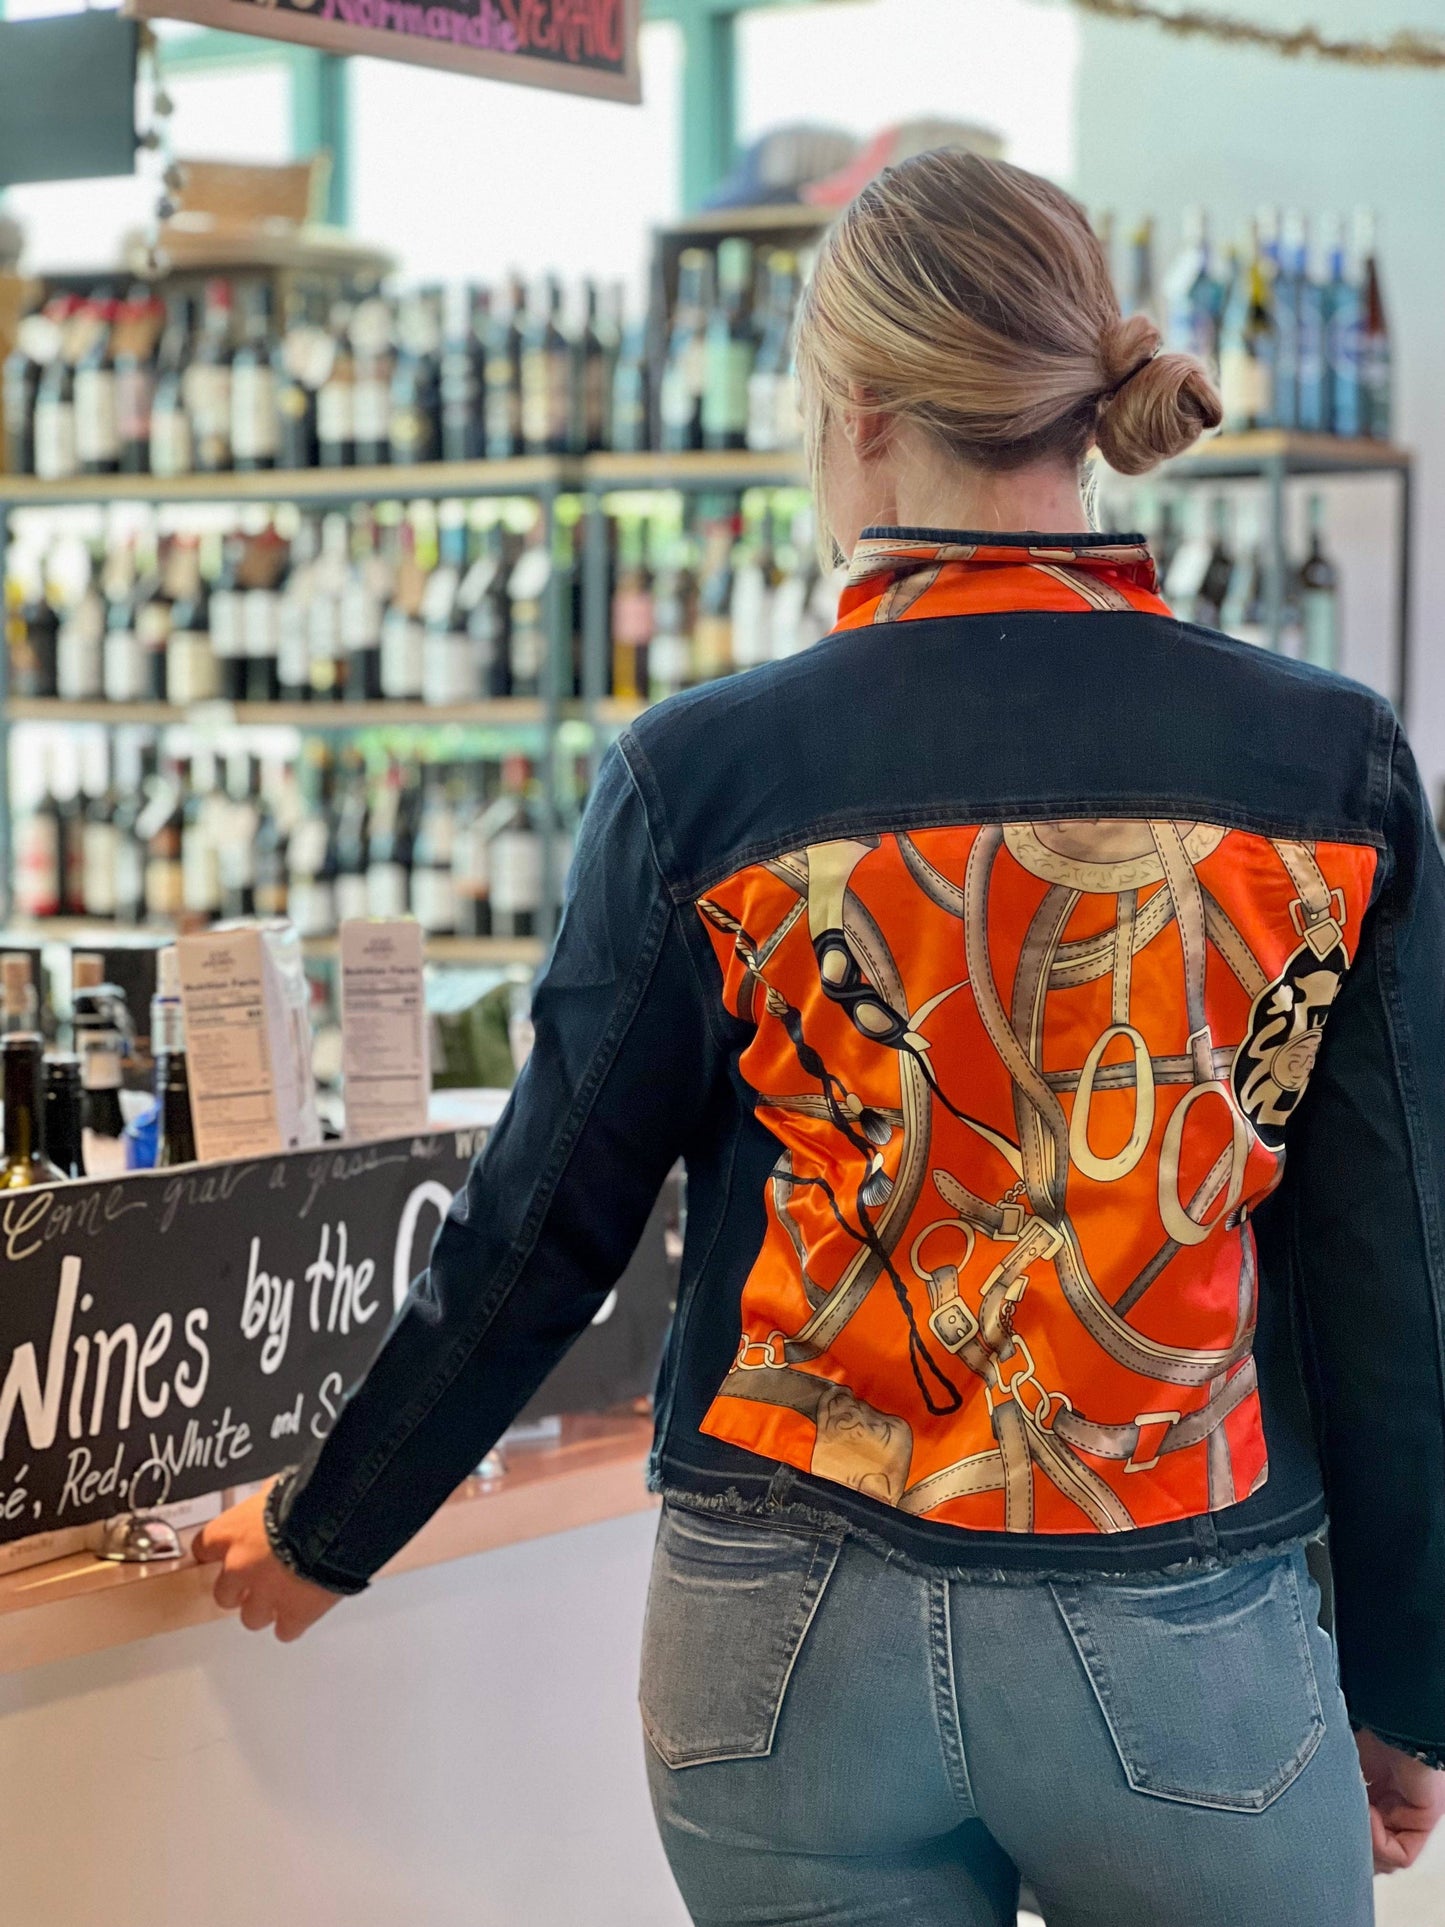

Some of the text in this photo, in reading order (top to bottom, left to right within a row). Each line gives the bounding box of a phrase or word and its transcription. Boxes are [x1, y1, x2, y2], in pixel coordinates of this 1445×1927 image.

[0, 1255, 210, 1459] Wines
[240, 1236, 295, 1374] by
[305, 1220, 380, 1334] the
[57, 1442, 130, 1516] Red,
[149, 1406, 253, 1481] White
[270, 1393, 304, 1439] and
